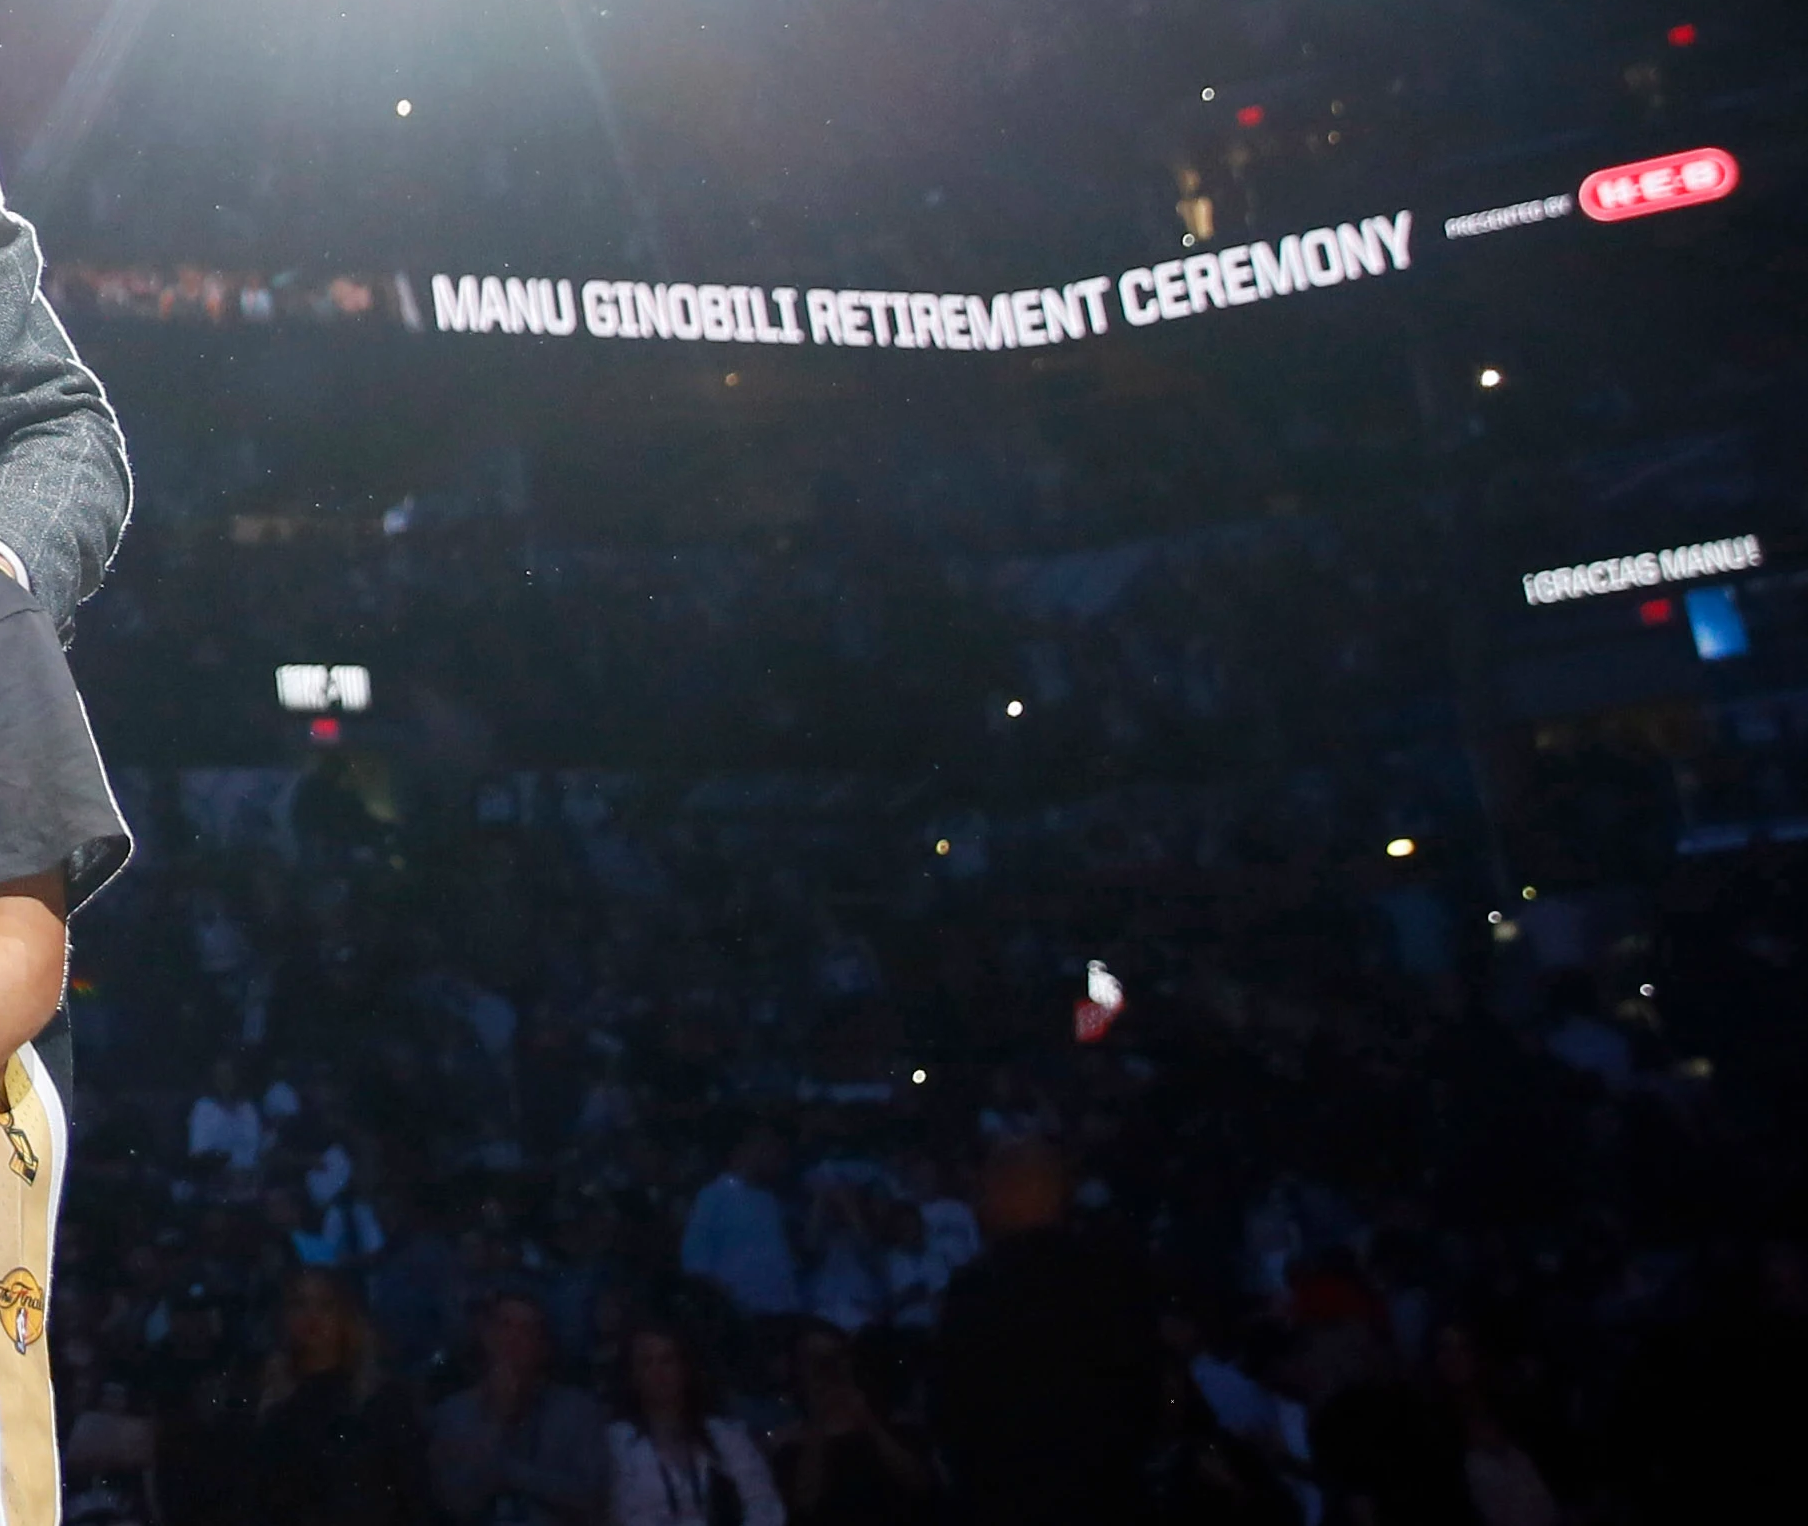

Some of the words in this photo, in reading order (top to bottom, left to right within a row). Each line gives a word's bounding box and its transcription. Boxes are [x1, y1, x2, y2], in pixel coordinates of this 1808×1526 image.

[431, 273, 577, 336] MANU
[582, 279, 804, 344] GINOBILI
[805, 275, 1112, 352] RETIREMENT
[1117, 209, 1413, 327] CEREMONY
[1658, 534, 1763, 582] MANU!
